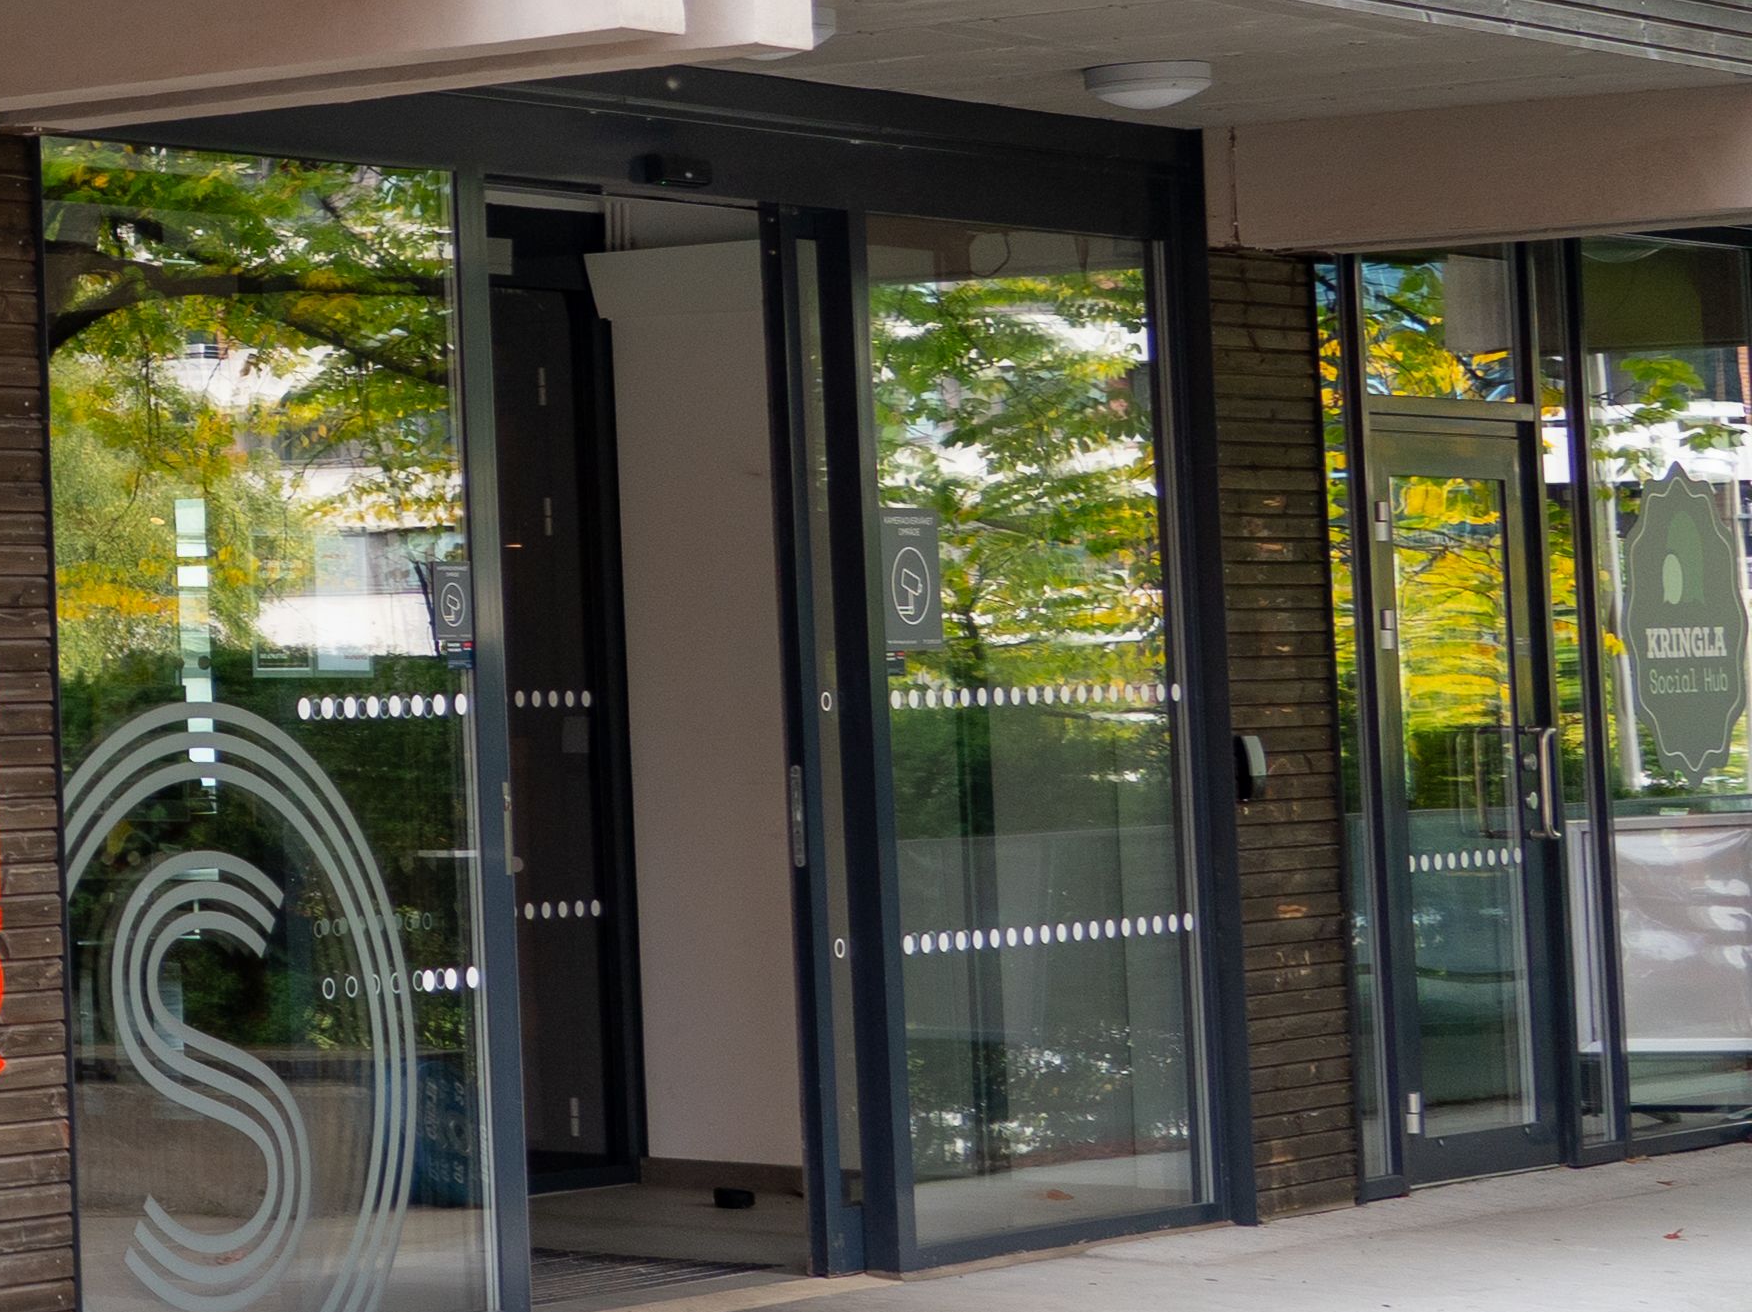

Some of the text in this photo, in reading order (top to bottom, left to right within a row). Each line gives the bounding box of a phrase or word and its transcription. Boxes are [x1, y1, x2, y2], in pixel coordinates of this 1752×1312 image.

[1645, 626, 1728, 659] KRINGLA
[1648, 667, 1729, 695] Social Hub
